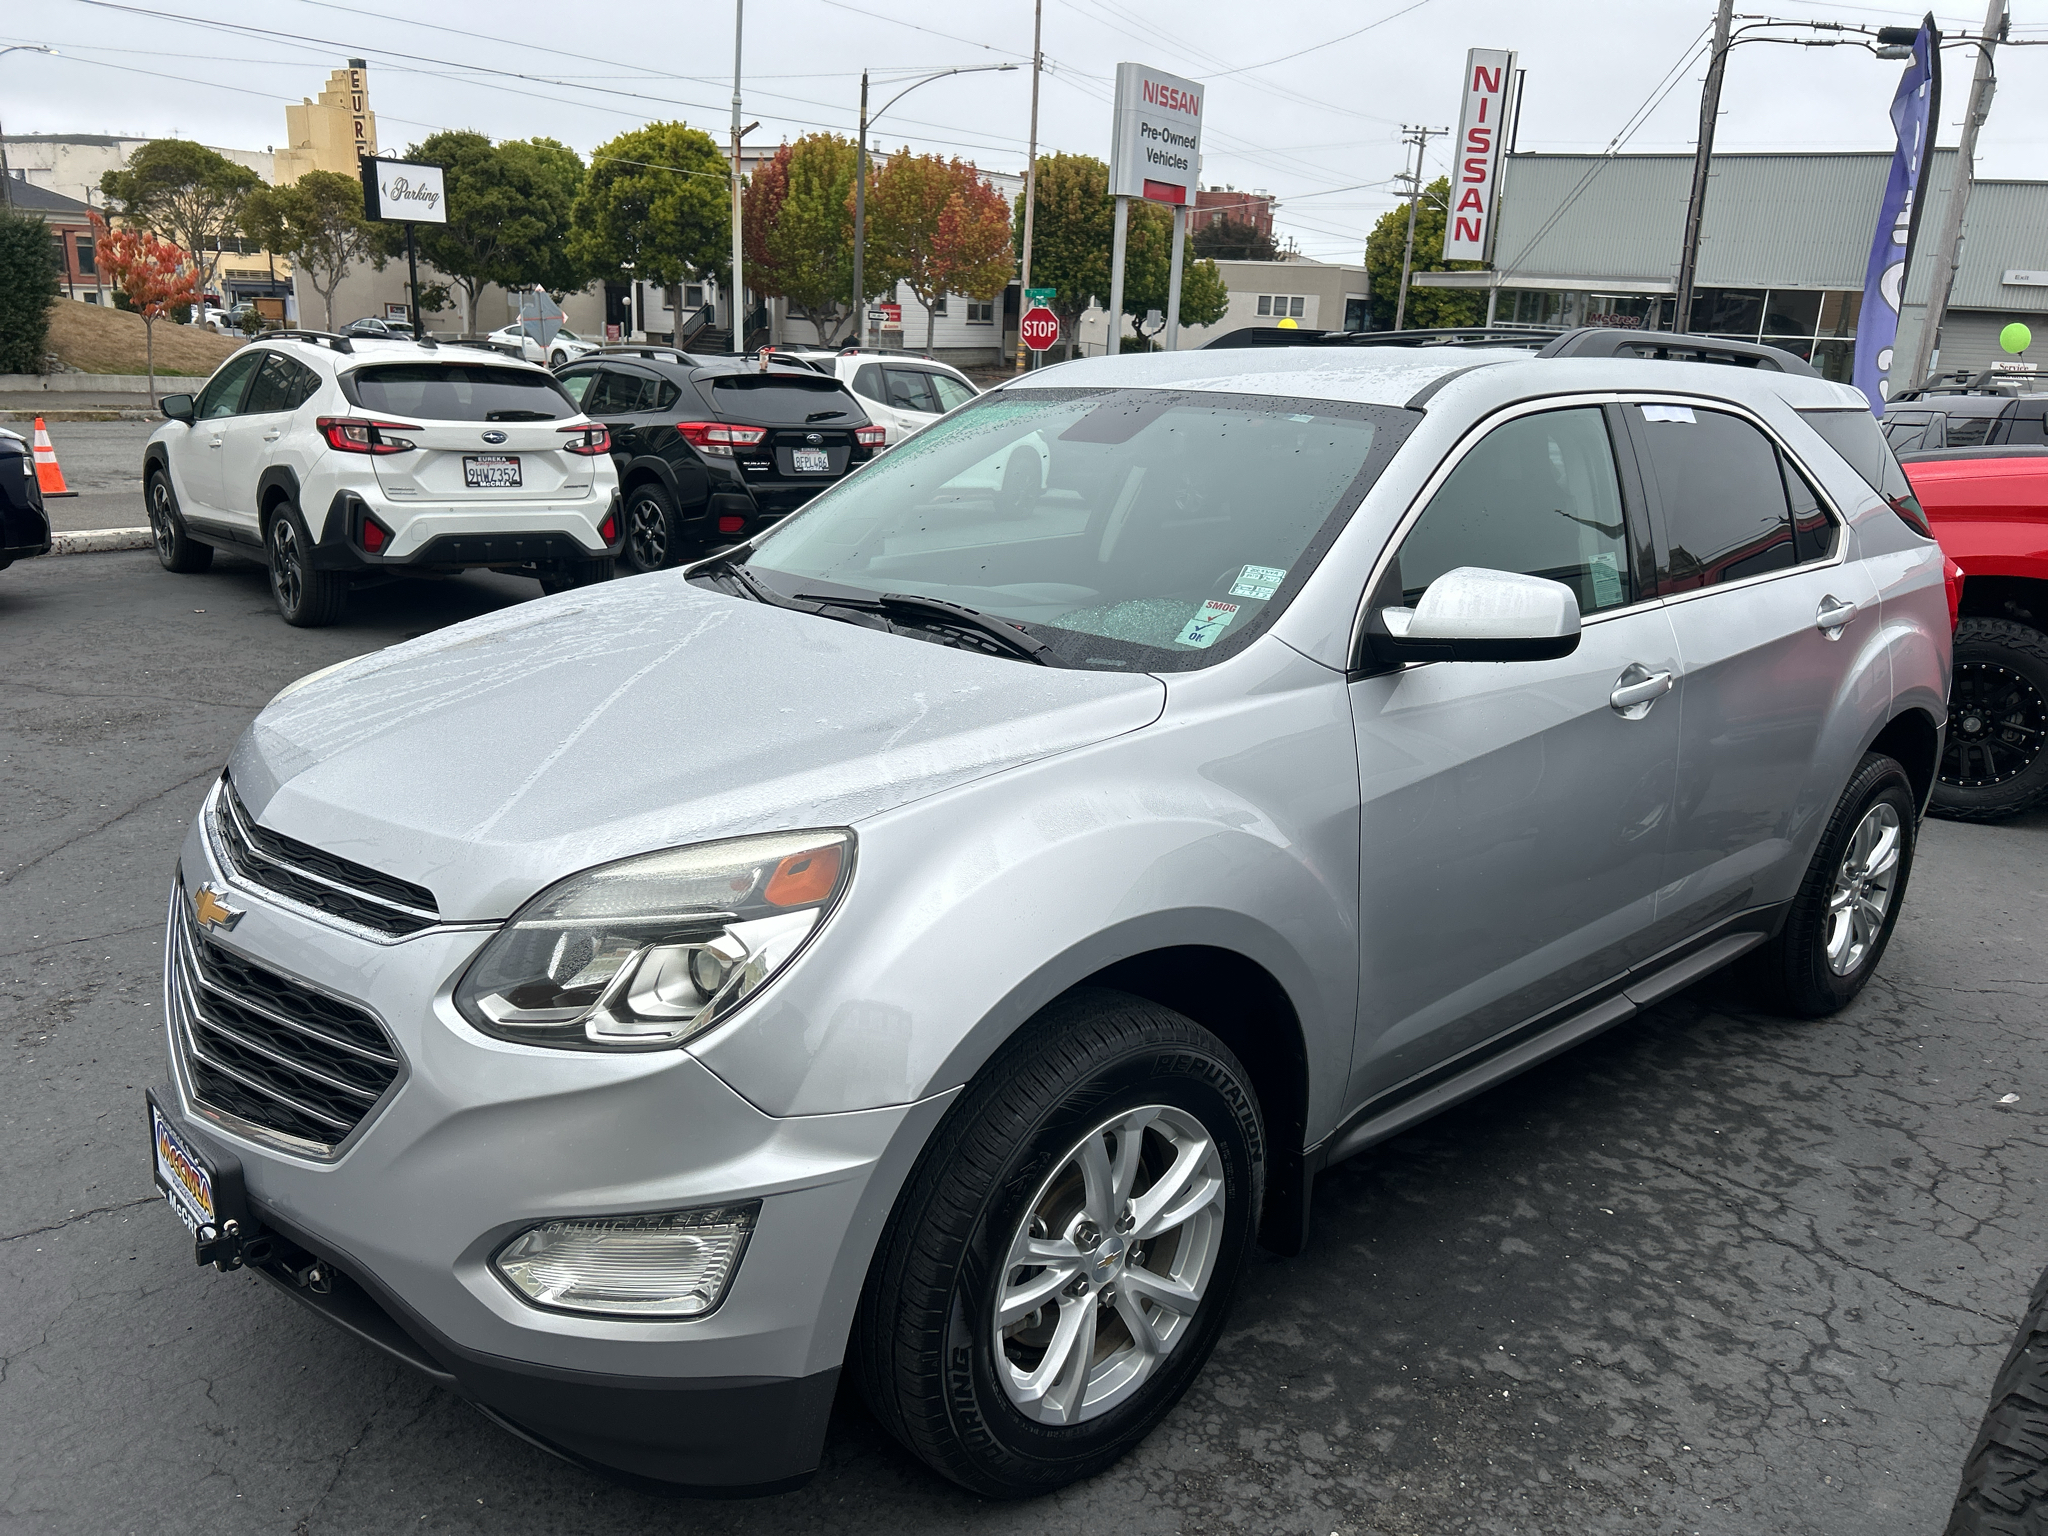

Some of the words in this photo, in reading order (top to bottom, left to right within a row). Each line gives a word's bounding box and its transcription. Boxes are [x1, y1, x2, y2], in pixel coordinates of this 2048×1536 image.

[1143, 79, 1199, 116] NISSAN
[1141, 122, 1196, 149] Pre-Owned
[1147, 147, 1188, 170] Vehicles
[1454, 66, 1501, 242] NISSAN
[390, 177, 440, 209] Parking
[1023, 320, 1057, 337] STOP
[1589, 313, 1640, 325] McCrea
[1999, 363, 2029, 371] Service
[468, 467, 517, 482] 9HWZ352
[1205, 601, 1238, 613] SMOG
[1188, 632, 1206, 643] OK
[1150, 1053, 1262, 1163] REPUTATION
